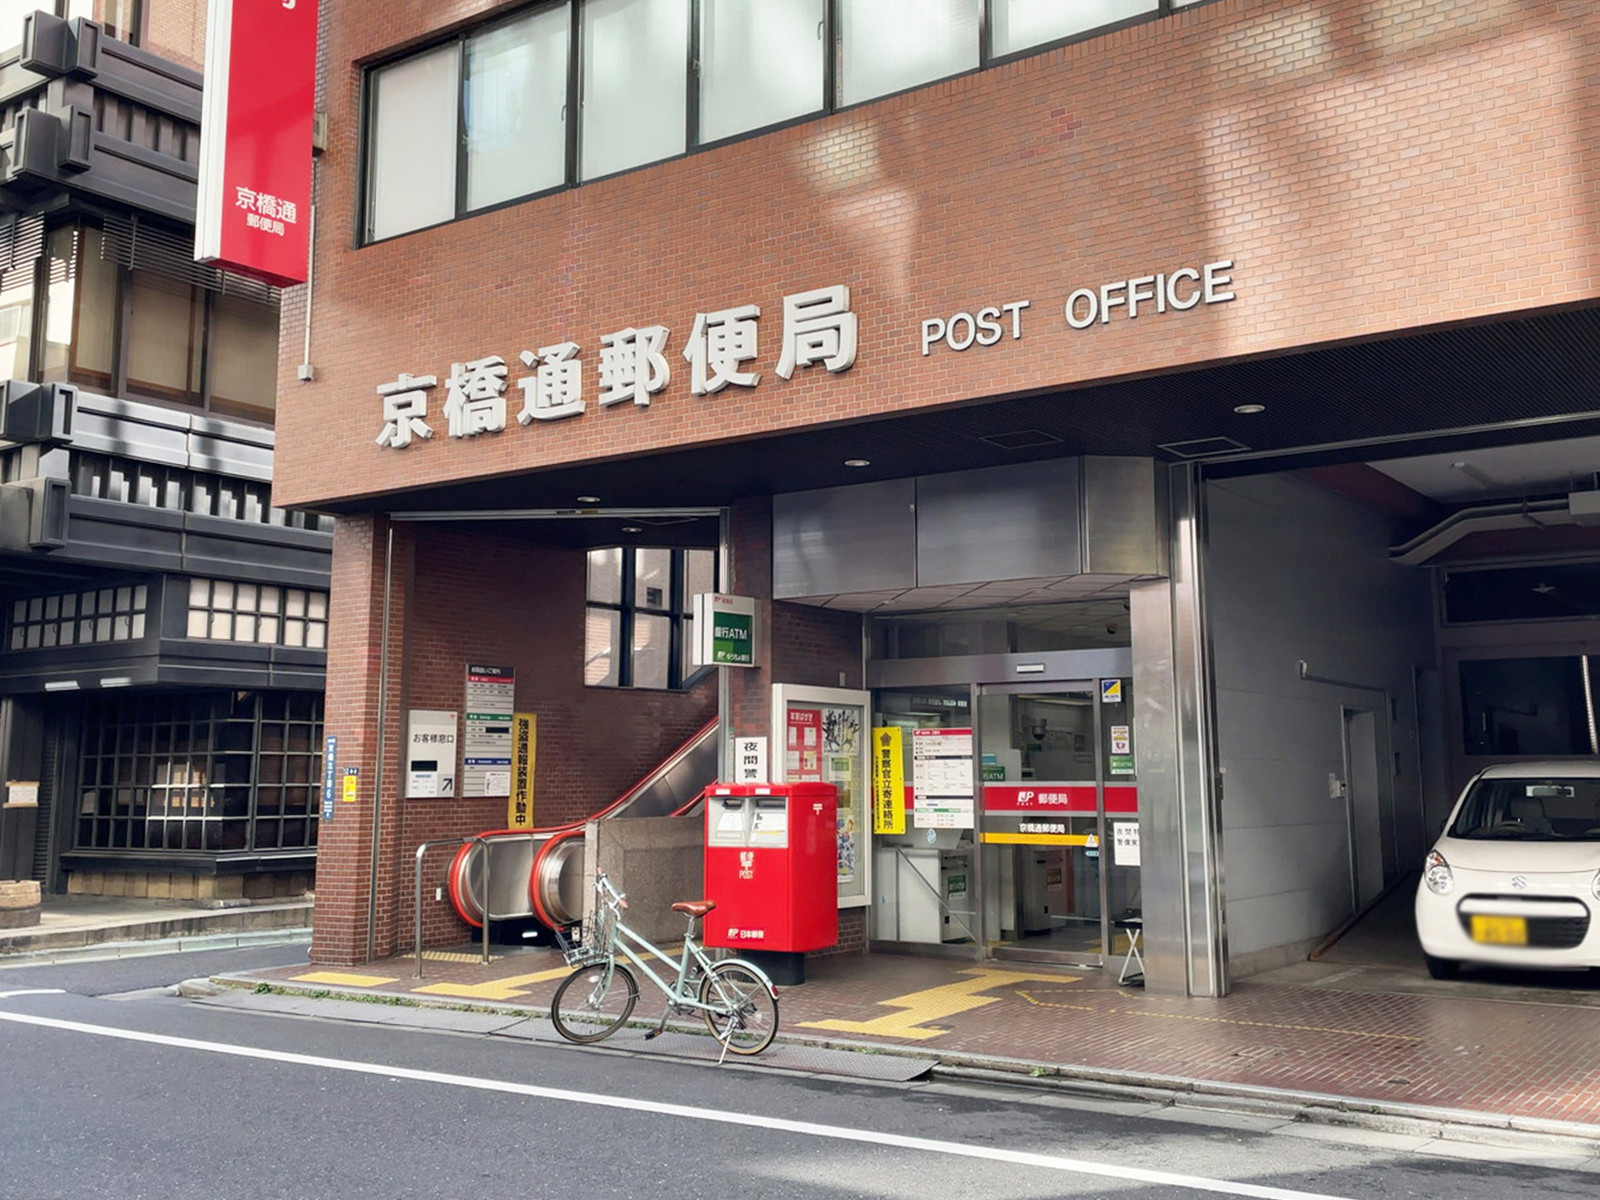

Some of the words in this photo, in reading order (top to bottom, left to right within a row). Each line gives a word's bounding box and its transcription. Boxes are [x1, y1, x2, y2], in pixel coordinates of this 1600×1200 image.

[235, 186, 297, 224] 京橋通
[246, 212, 285, 237] 郵便局
[921, 300, 1031, 356] POST
[1065, 259, 1236, 329] OFFICE
[375, 284, 858, 449] 京橋通郵便局
[413, 733, 455, 743] お客様窓口
[743, 741, 759, 784] 夜間警
[881, 749, 894, 830] 警察官立寄連絡所
[1038, 793, 1068, 805] 郵便局
[739, 870, 753, 879] POST
[740, 929, 764, 939] 日本郵便
